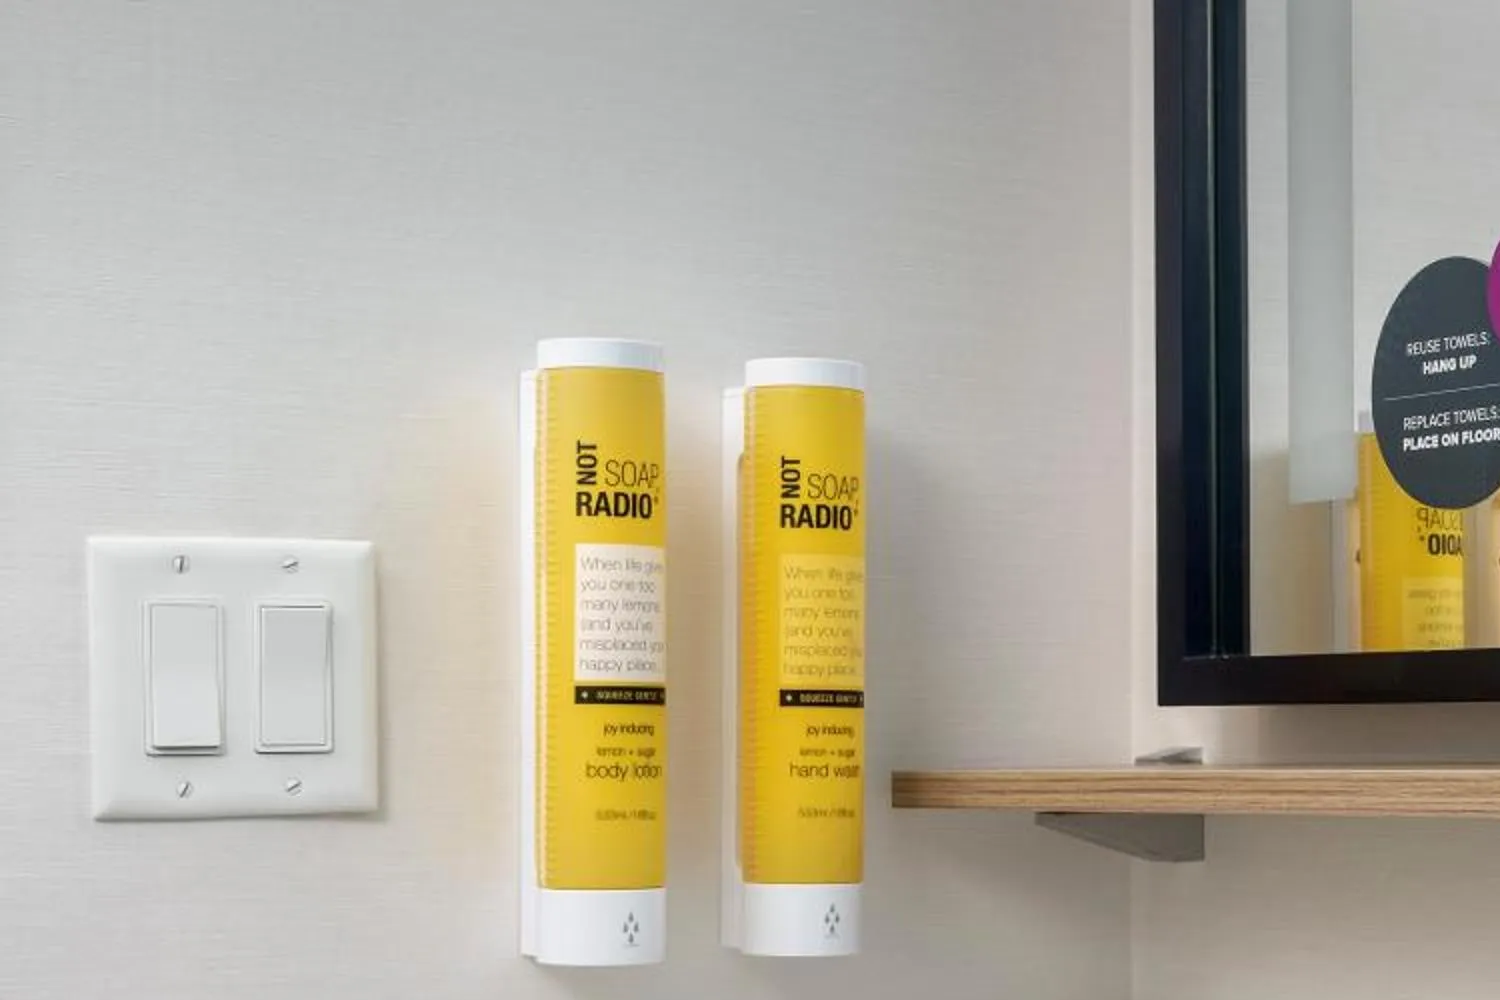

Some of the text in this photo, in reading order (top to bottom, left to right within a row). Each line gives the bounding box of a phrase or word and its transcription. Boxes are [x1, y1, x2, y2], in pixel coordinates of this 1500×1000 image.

[1406, 338, 1441, 356] REUSE
[1423, 354, 1477, 375] HANG UP
[1403, 411, 1451, 431] REPLACE
[1403, 427, 1500, 452] PLACE ON FLOOR
[576, 439, 597, 486] NOT
[781, 455, 801, 498] NOT
[581, 557, 622, 571] When
[581, 580, 607, 593] you
[609, 580, 635, 592] one
[582, 599, 620, 615] many
[580, 658, 622, 673] happy
[585, 761, 629, 782] body
[789, 762, 829, 778] hand
